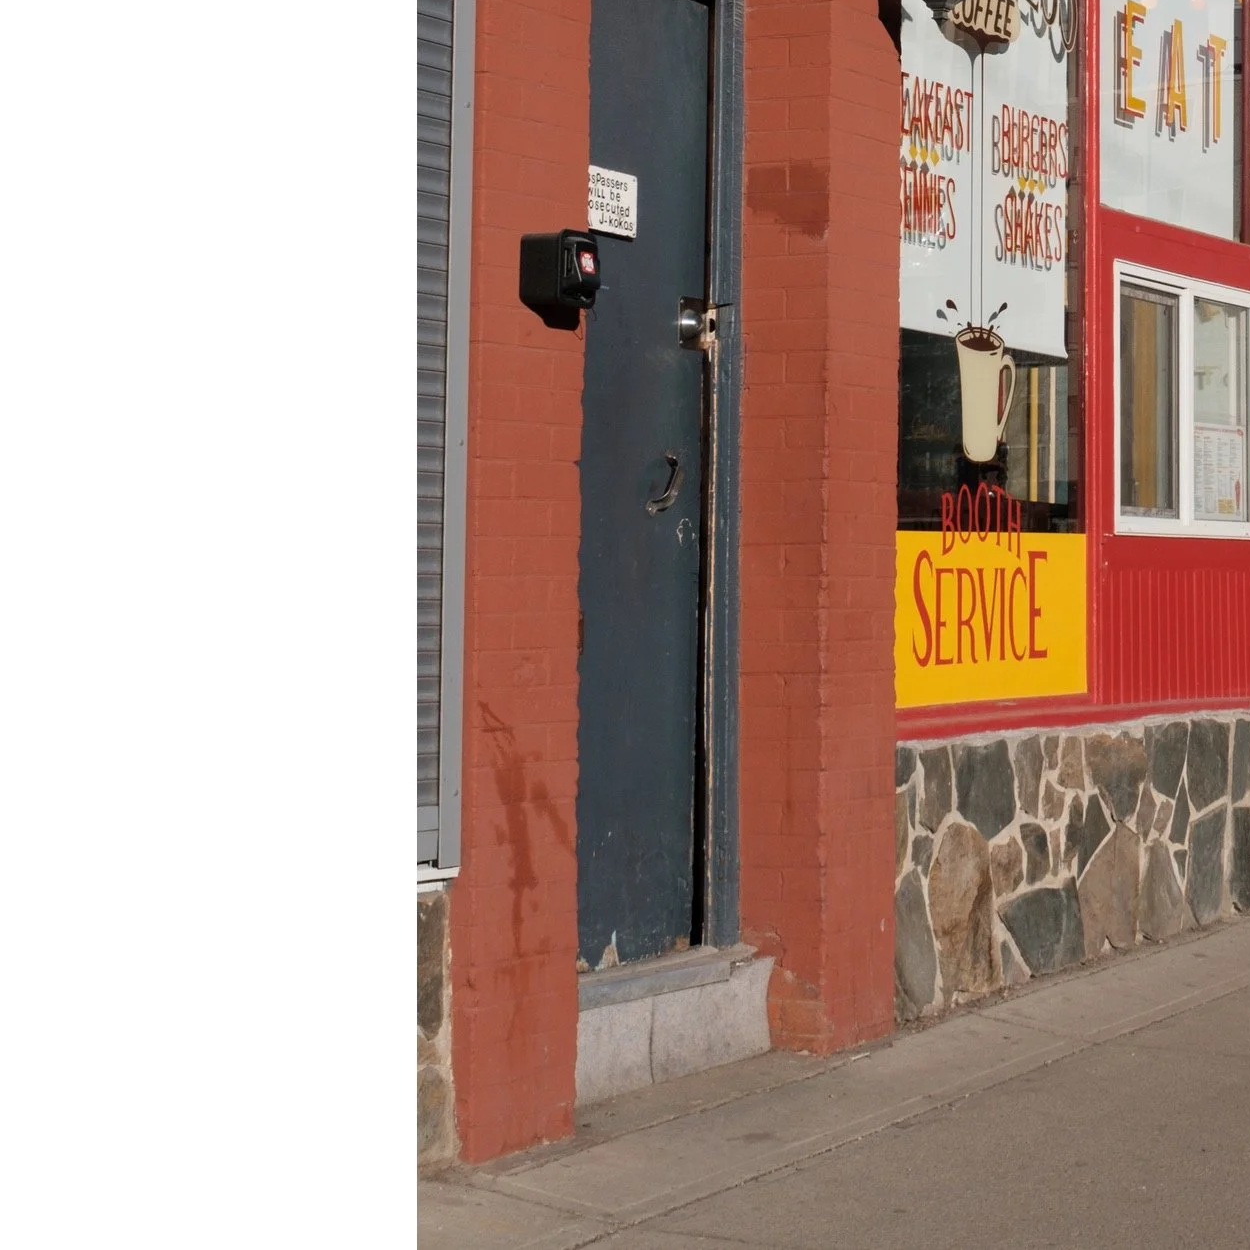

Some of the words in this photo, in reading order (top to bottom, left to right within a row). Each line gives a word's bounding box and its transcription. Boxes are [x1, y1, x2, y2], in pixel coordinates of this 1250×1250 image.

[1001, 104, 1069, 179] BURGERS
[610, 189, 621, 202] be
[900, 165, 956, 240] ENNIES
[1003, 194, 1063, 262] SHAKES
[942, 481, 1022, 559] BOOTH
[912, 549, 1048, 667] SERVICE
